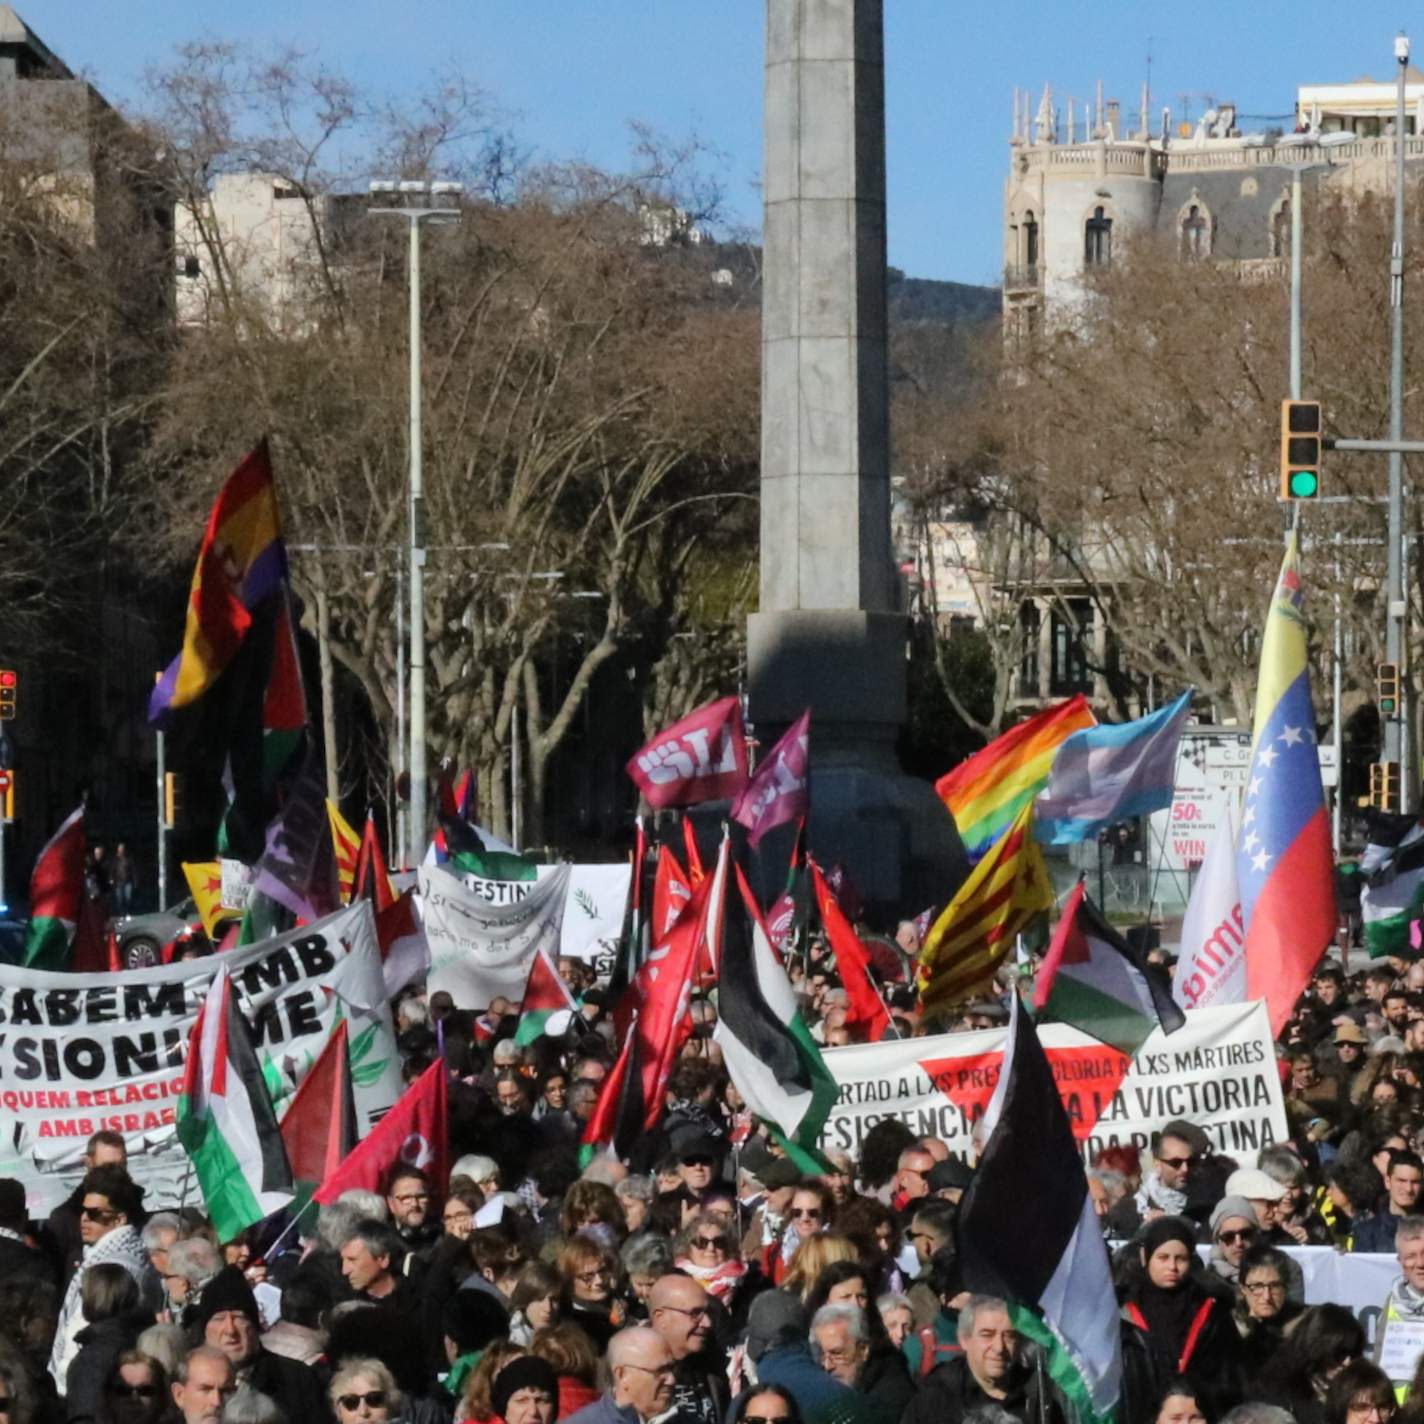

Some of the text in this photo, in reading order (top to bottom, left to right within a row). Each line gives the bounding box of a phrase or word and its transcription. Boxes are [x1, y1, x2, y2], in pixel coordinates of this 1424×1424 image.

[216, 933, 337, 1003] MB
[1136, 1053, 1171, 1077] LXS
[1175, 1039, 1266, 1073] MÁRTIRES
[77, 1077, 187, 1108] RELACIO
[897, 1078, 910, 1098] A
[916, 1070, 953, 1095] LXS
[1135, 1073, 1272, 1119] VICTORIA
[38, 1108, 177, 1138] AMB ISRAE
